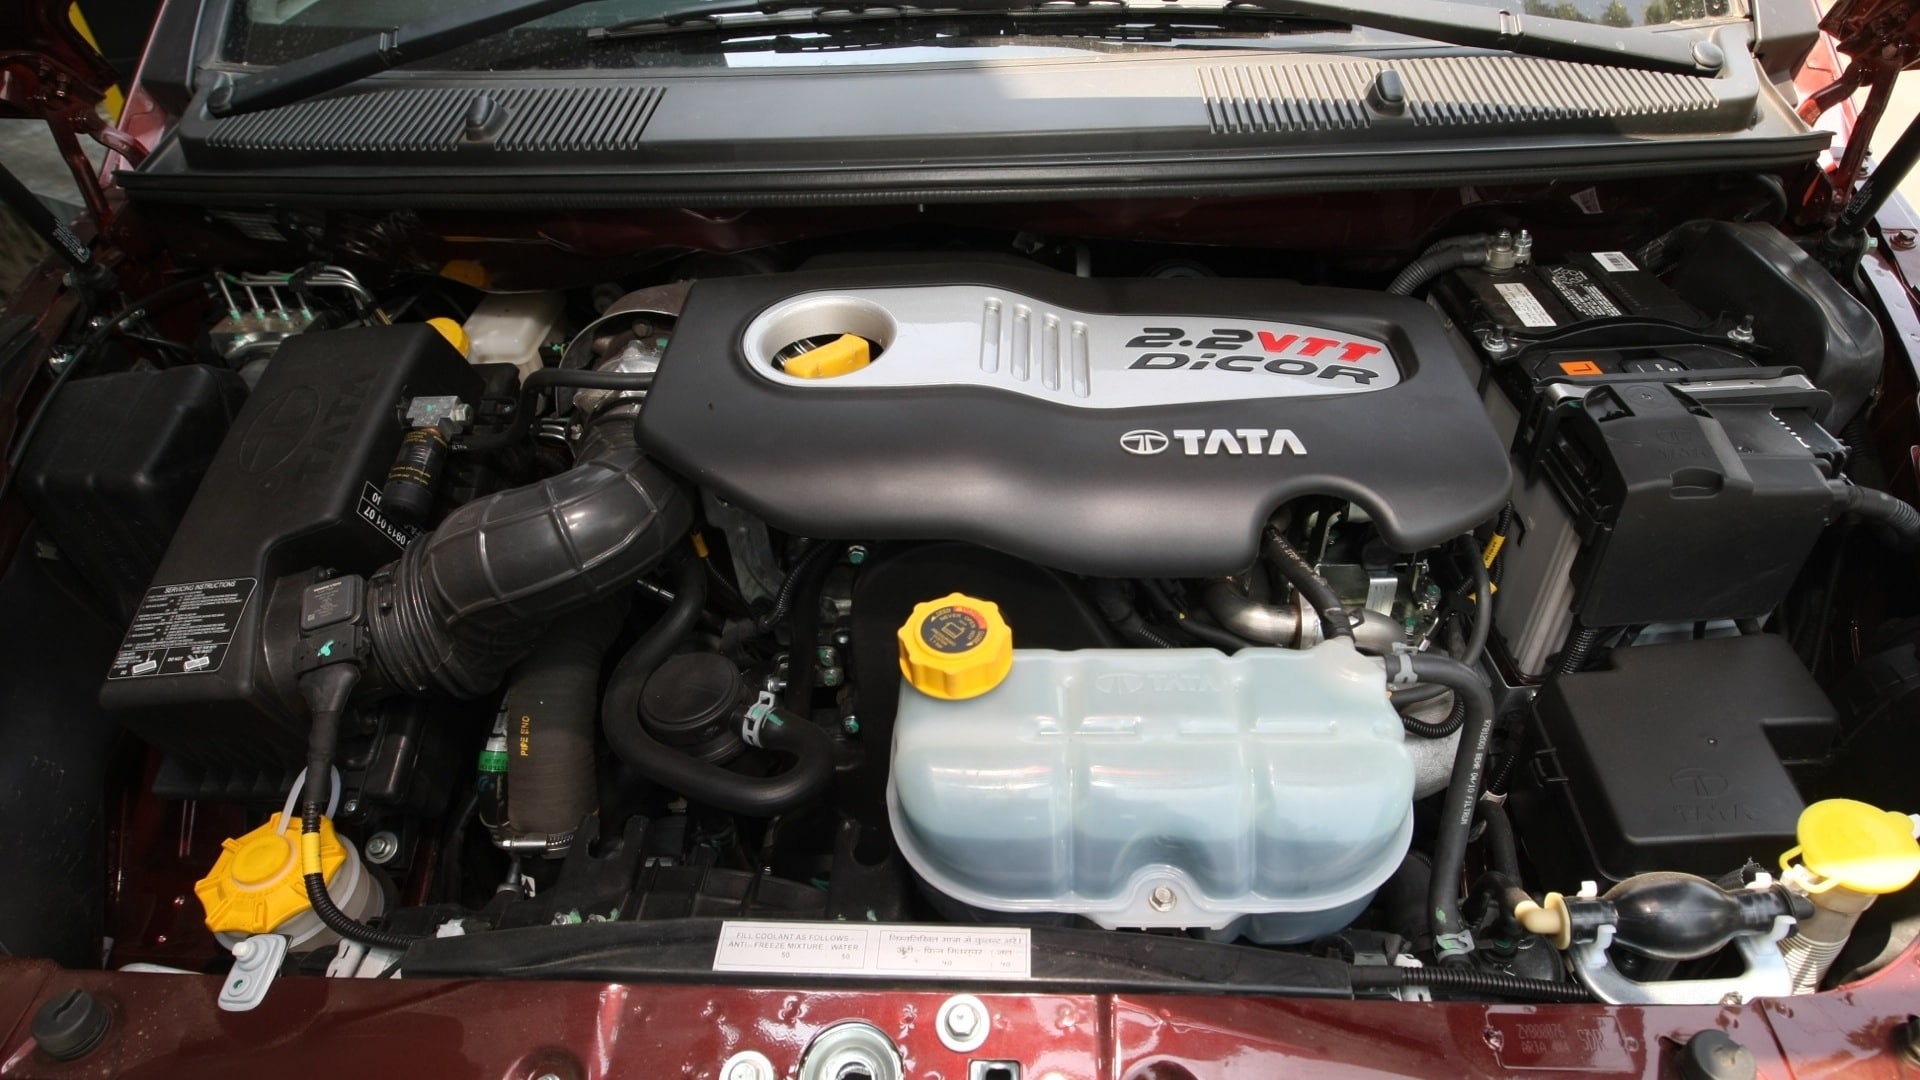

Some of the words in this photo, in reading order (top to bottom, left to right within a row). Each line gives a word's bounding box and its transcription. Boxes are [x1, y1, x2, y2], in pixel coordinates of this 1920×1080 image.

[1128, 352, 1379, 385] DiCOR
[1173, 428, 1308, 456] TATA
[736, 932, 753, 940] FILL
[755, 933, 794, 941] COOLANT
[781, 951, 790, 959] 50
